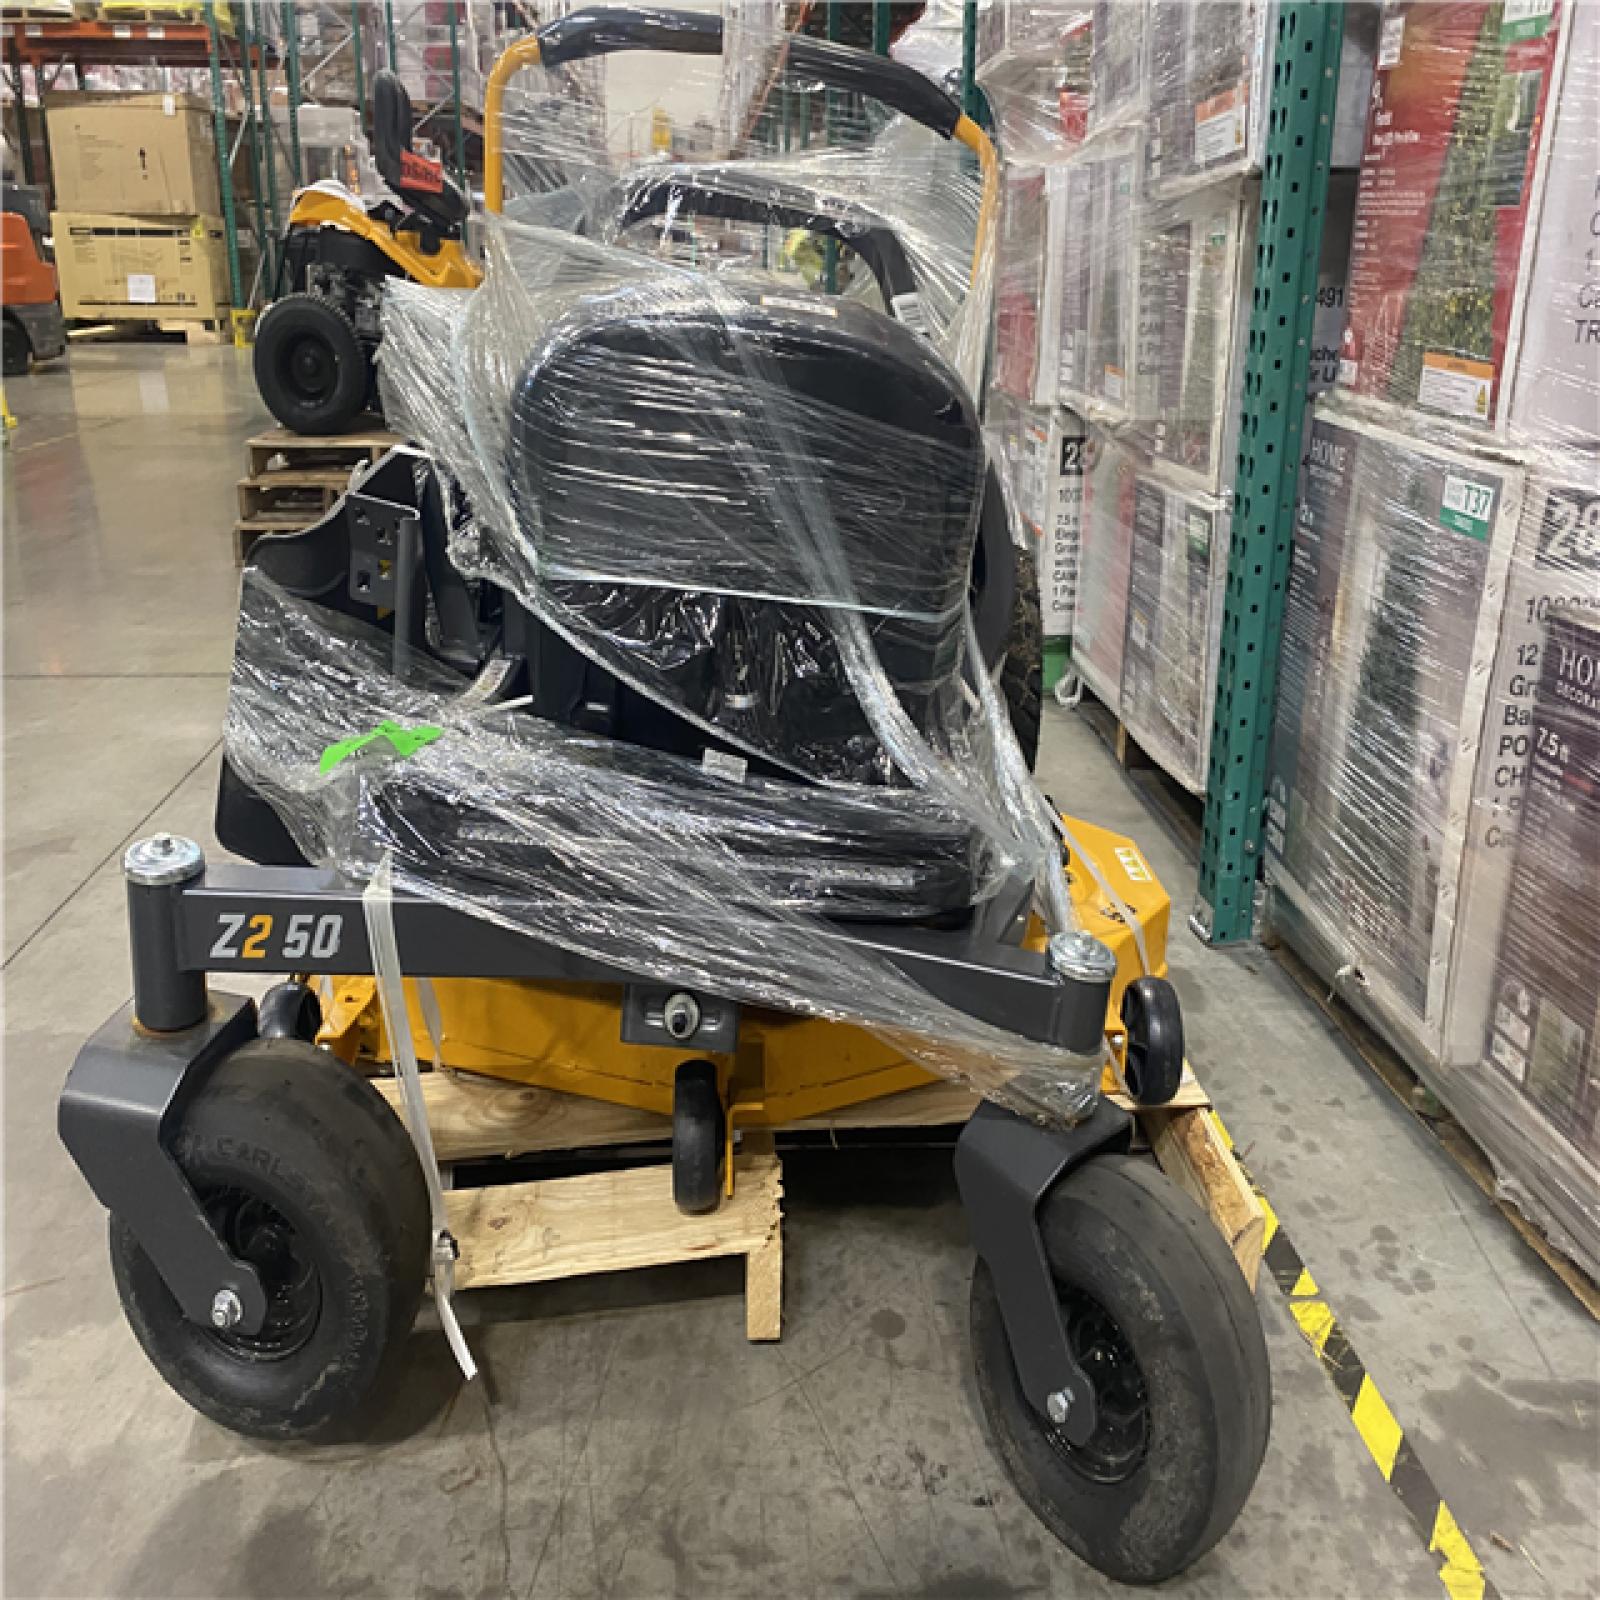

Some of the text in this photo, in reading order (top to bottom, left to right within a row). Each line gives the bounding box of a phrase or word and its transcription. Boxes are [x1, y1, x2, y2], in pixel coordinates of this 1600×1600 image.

[1311, 437, 1345, 472] HOME
[1517, 644, 1538, 666] 12
[208, 914, 343, 958] Z2 50
